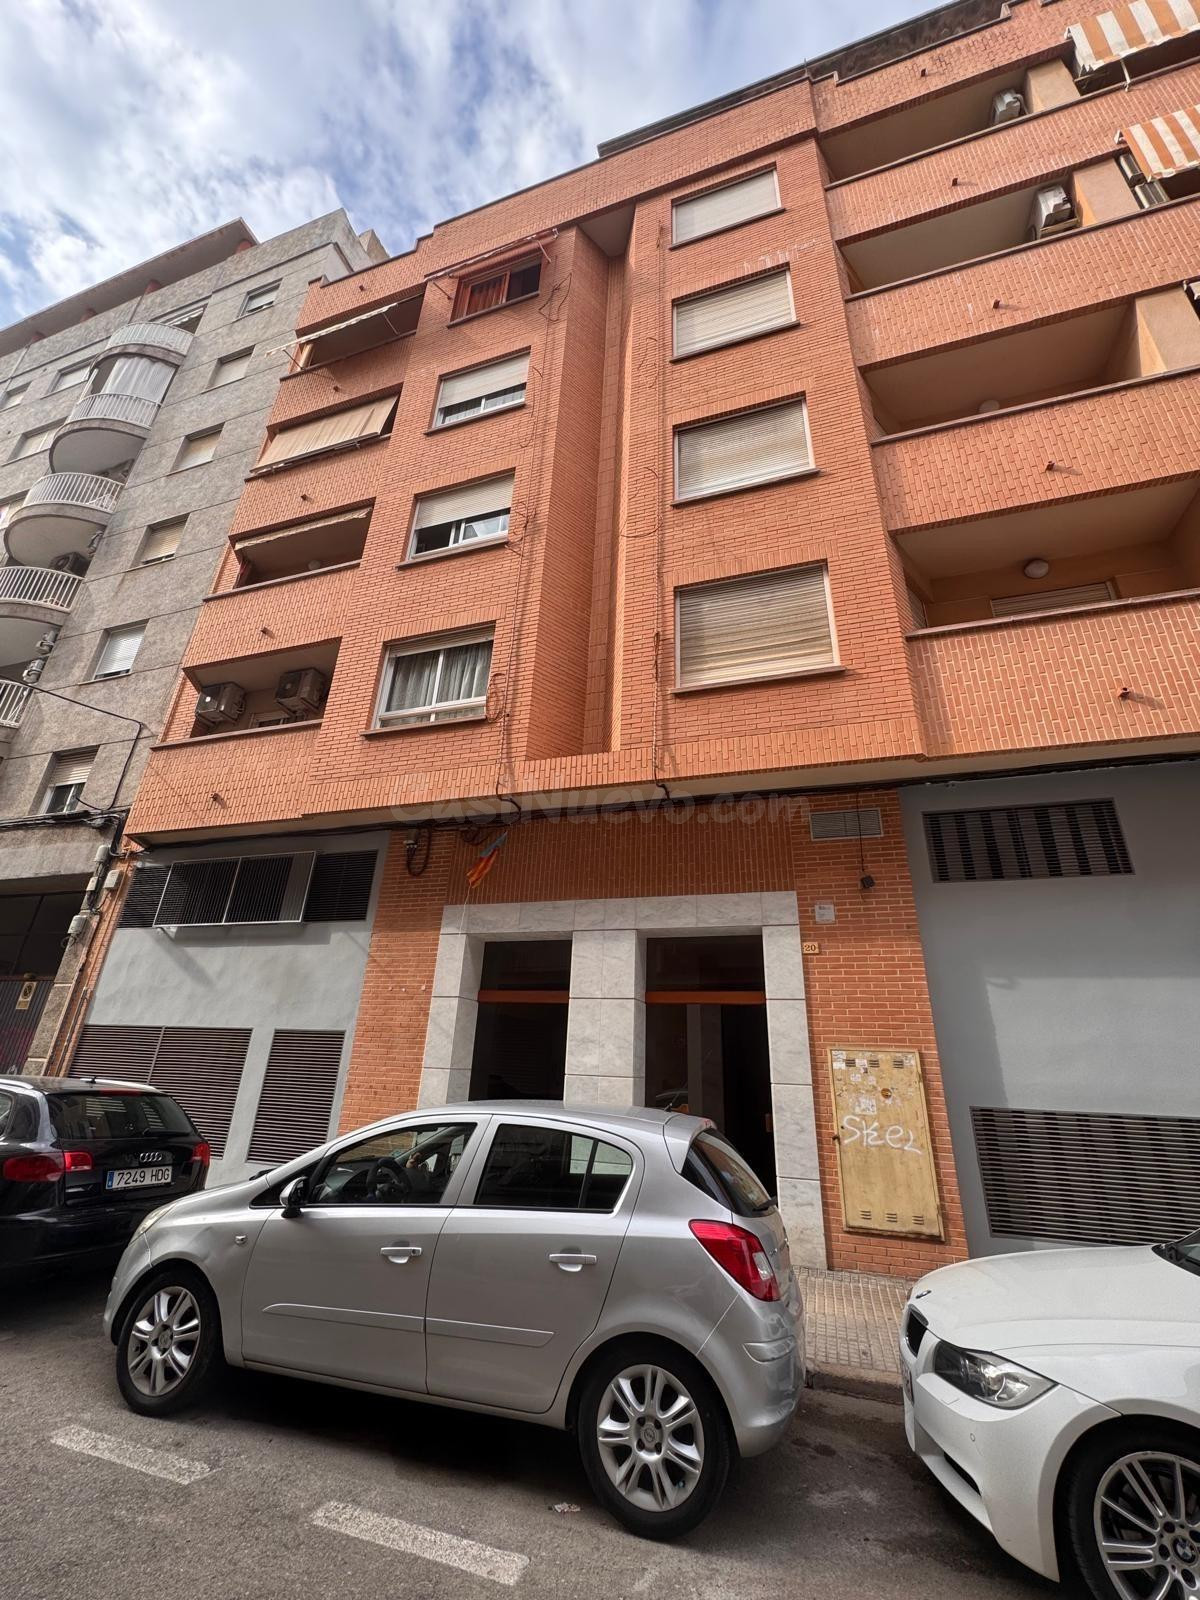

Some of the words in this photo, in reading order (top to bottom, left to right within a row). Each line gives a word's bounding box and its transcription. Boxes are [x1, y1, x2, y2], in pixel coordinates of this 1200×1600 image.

[804, 944, 816, 952] 20
[116, 1170, 146, 1186] 7249
[150, 1168, 170, 1182] HDG
